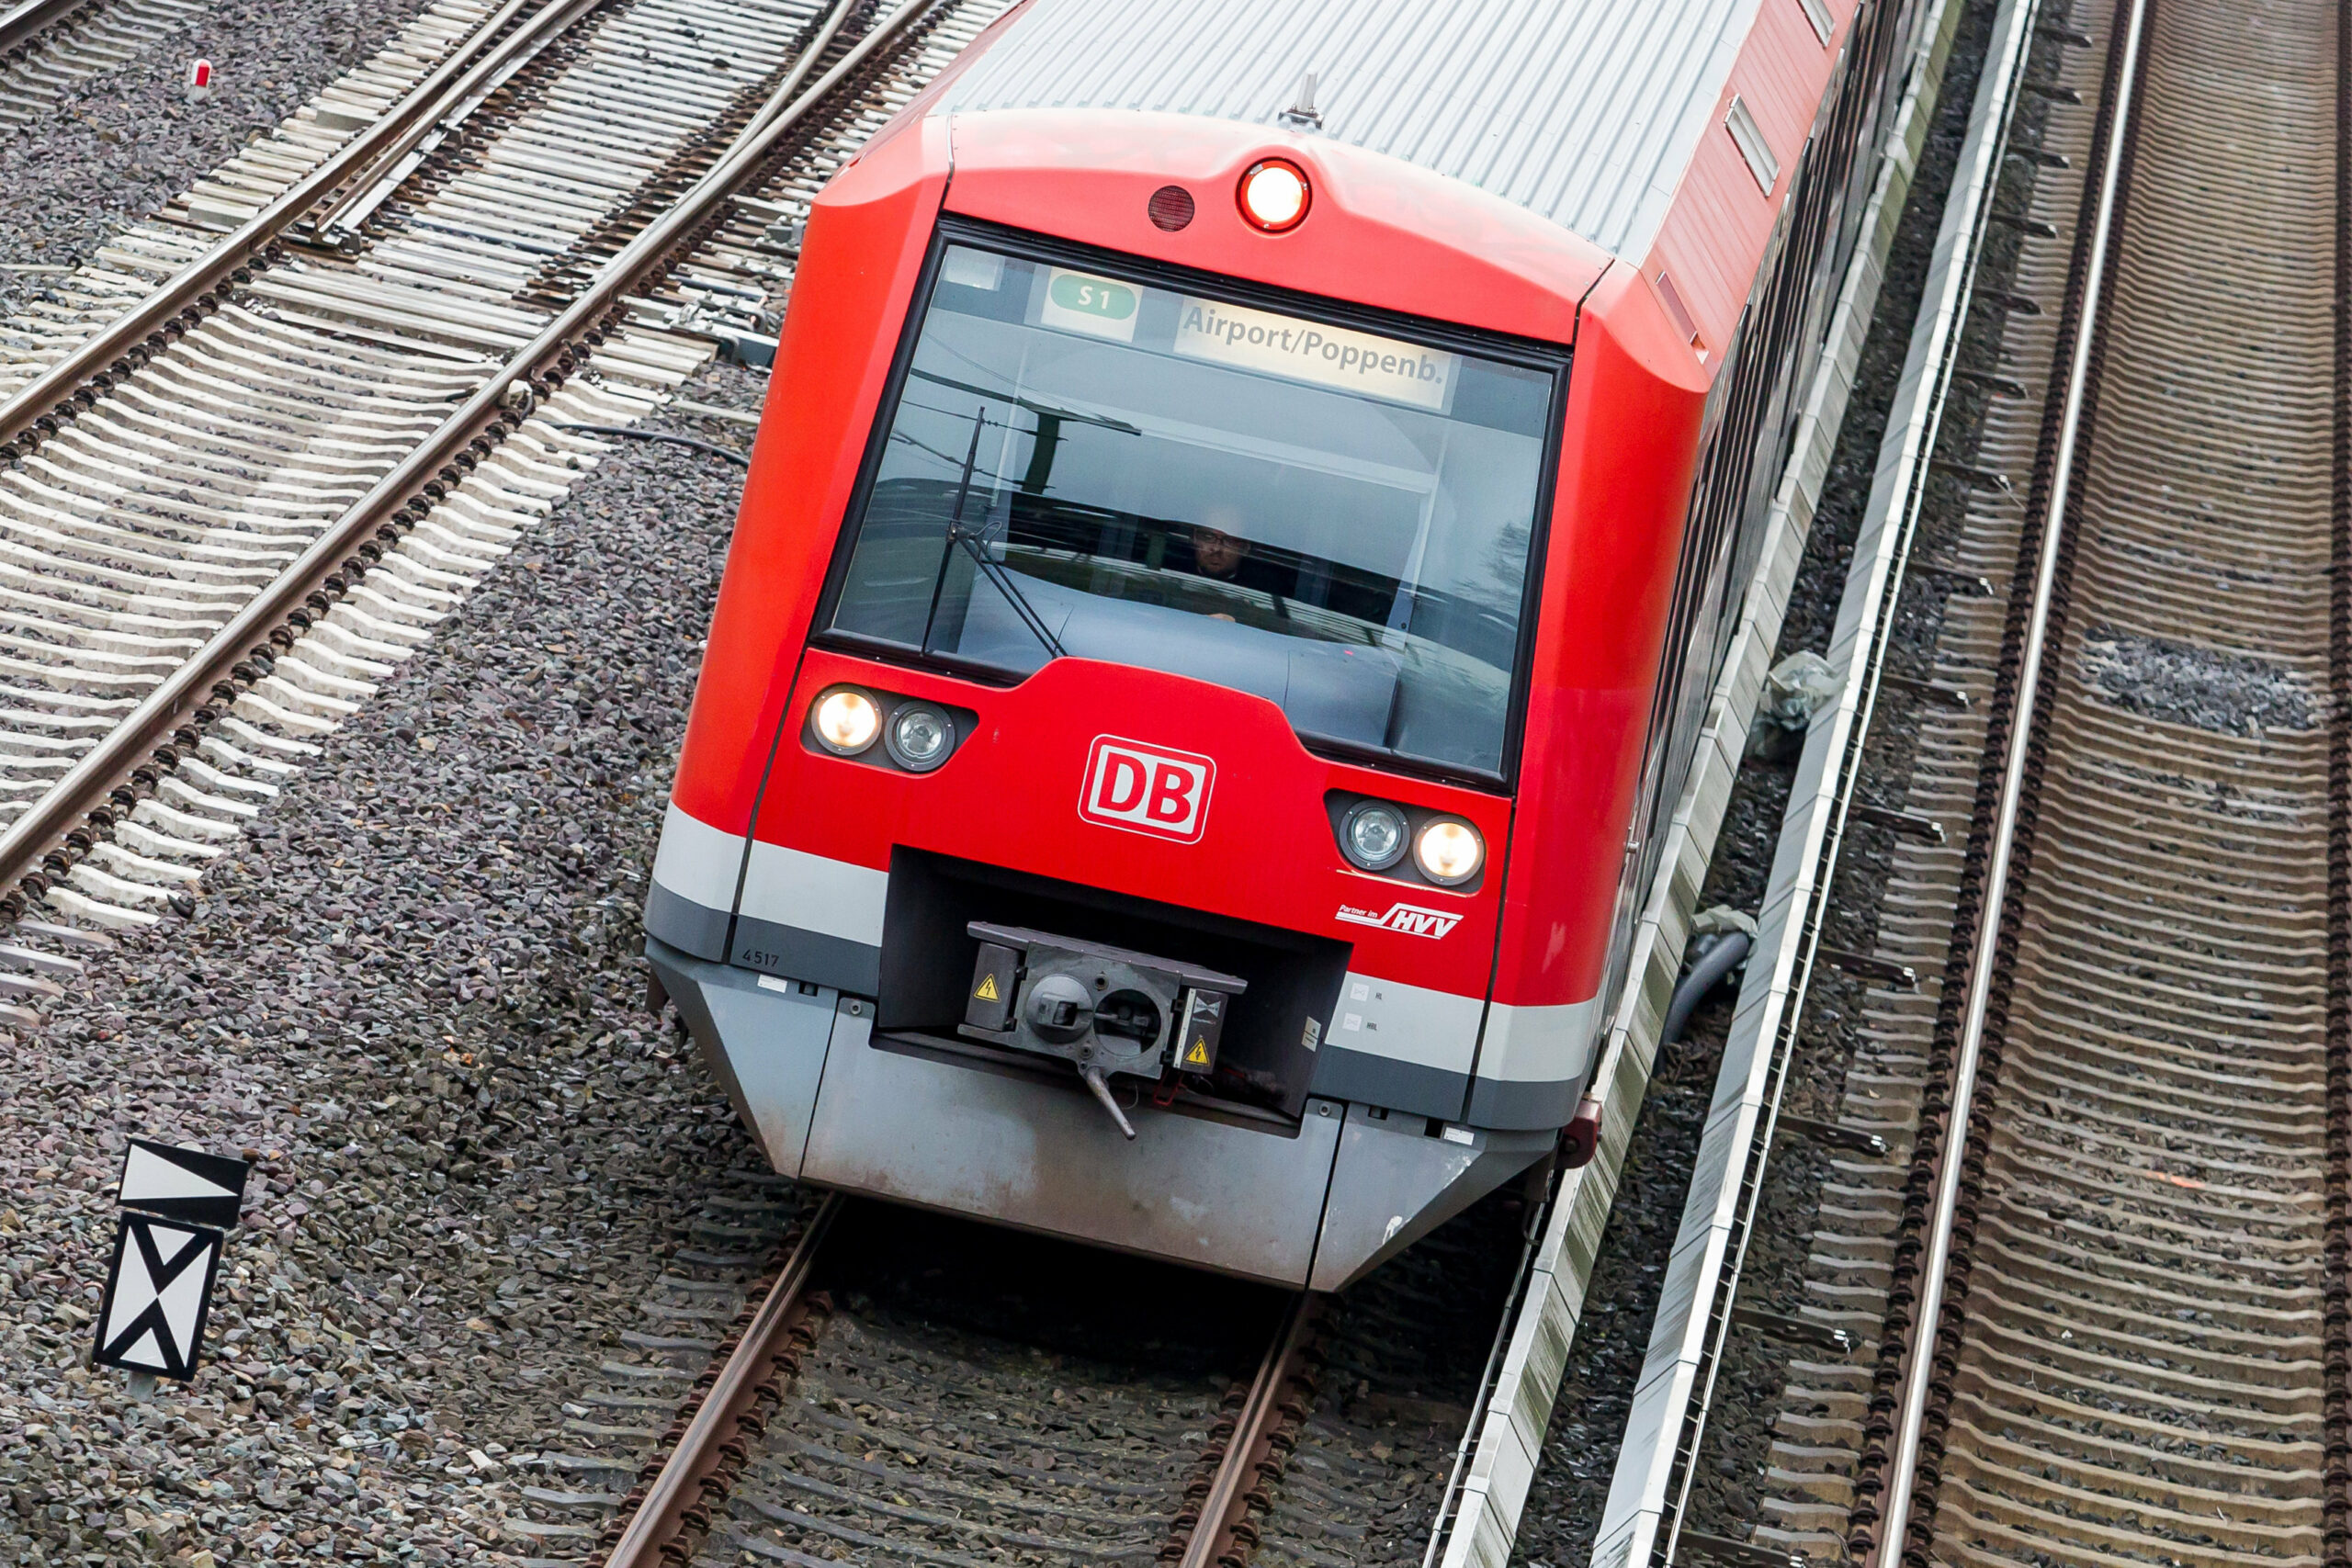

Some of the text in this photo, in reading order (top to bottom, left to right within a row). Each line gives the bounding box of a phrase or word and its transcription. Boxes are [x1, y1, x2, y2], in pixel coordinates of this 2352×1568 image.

[1183, 306, 1442, 384] Airport/Poppenb.
[1097, 751, 1194, 824] DB
[1339, 904, 1458, 938] Partner im HVV
